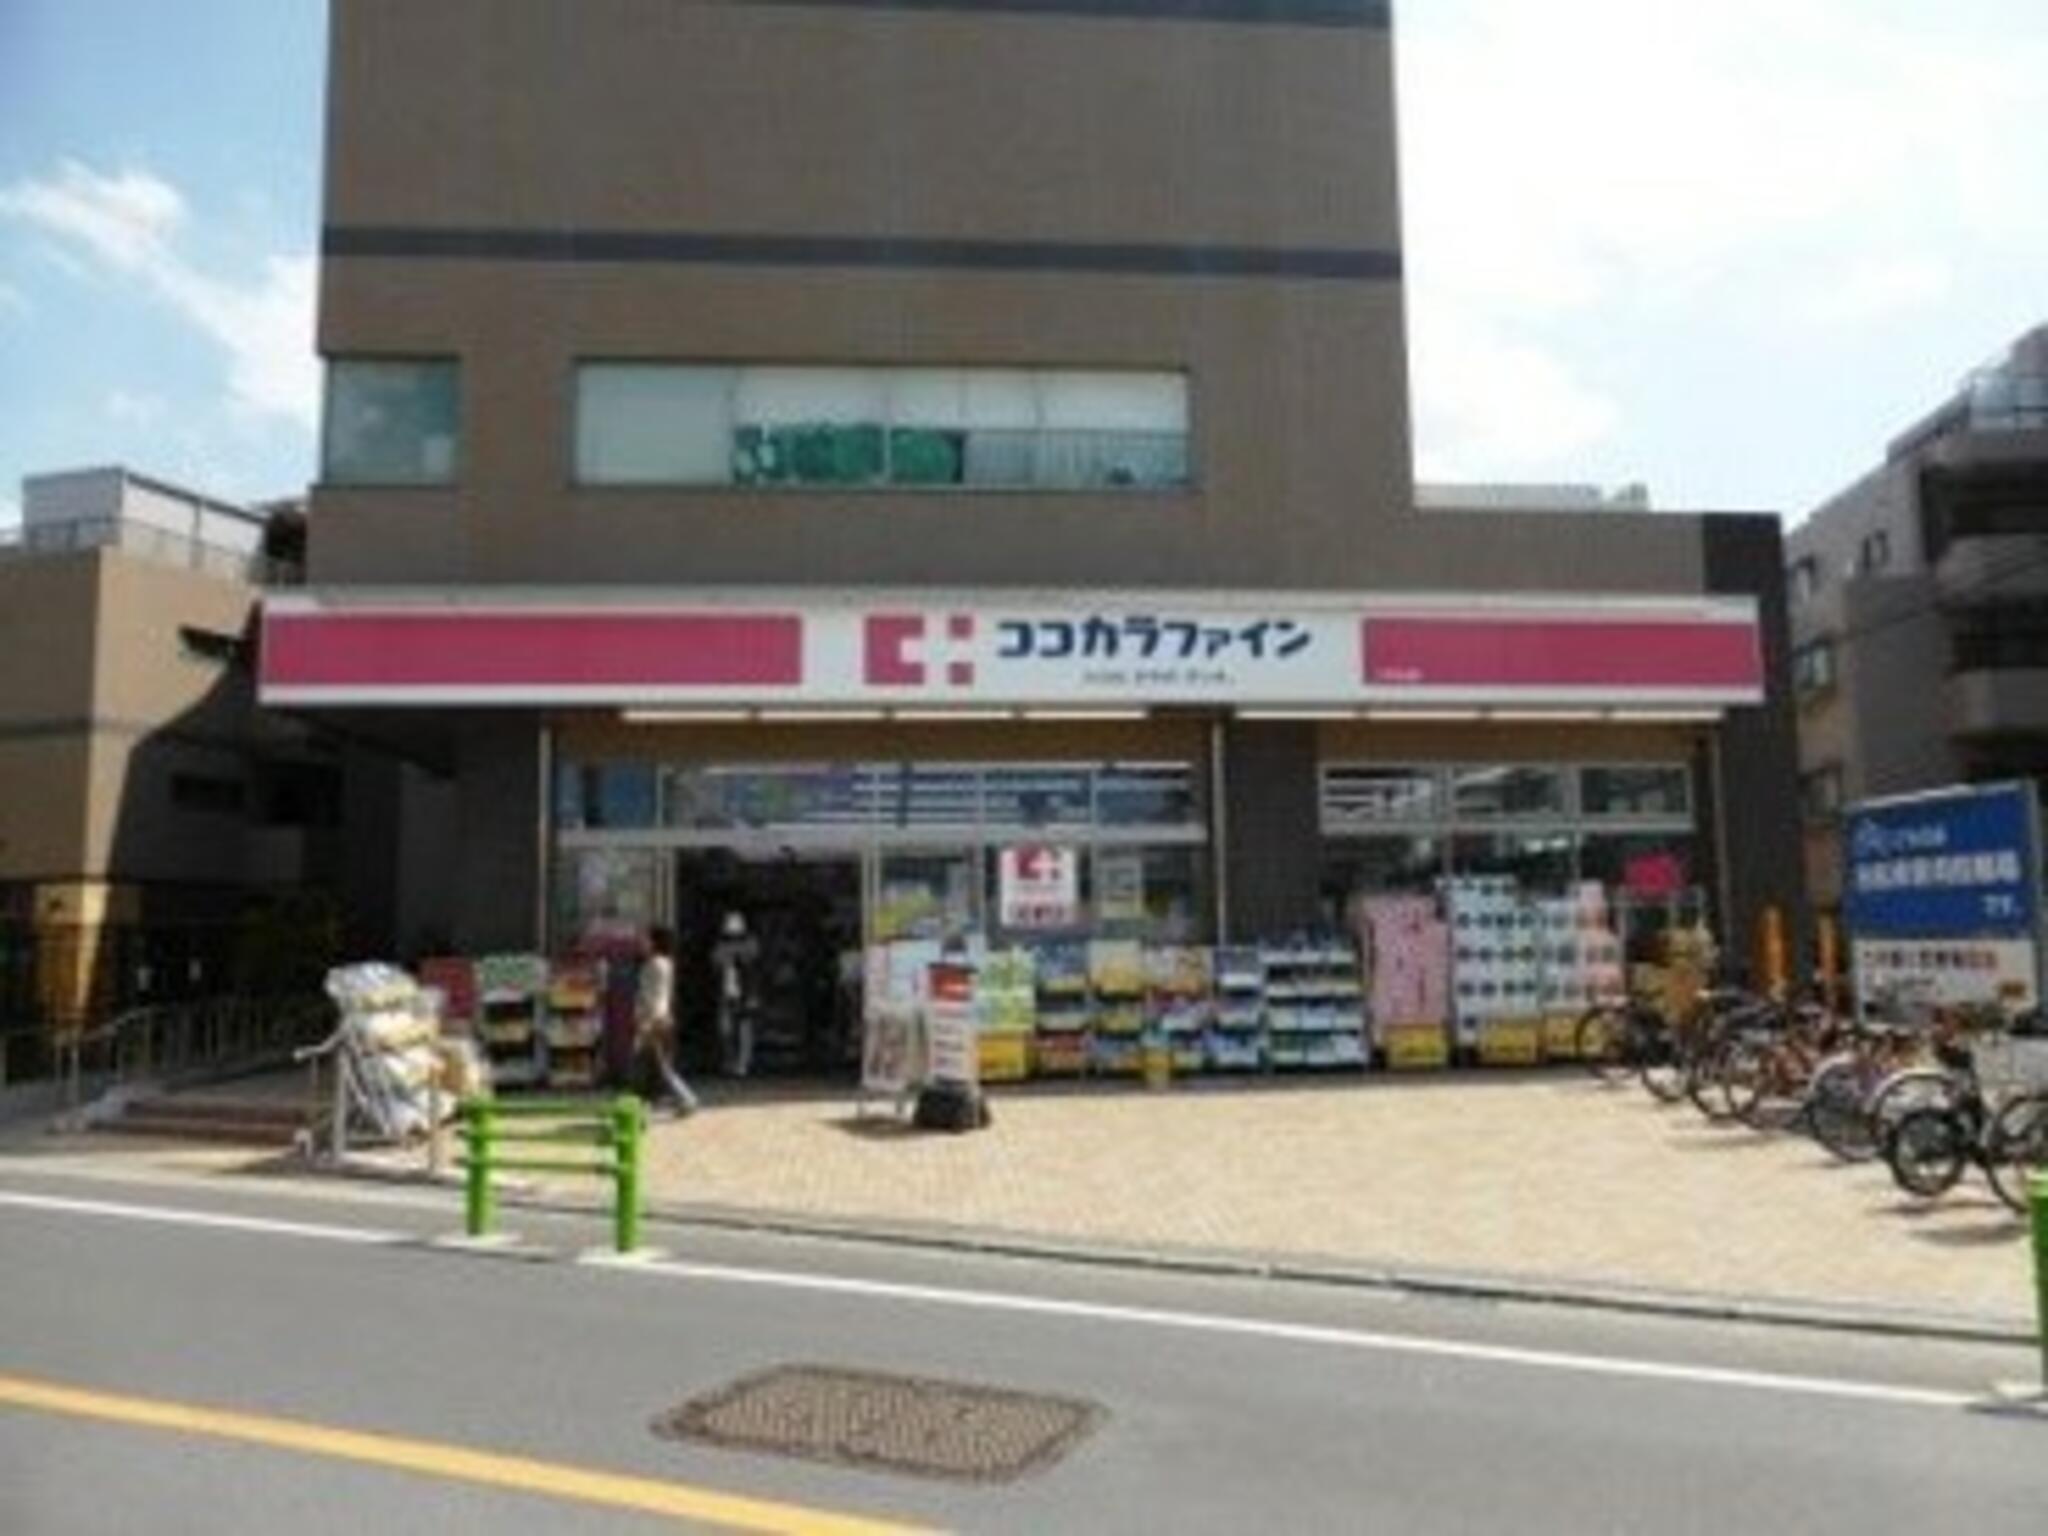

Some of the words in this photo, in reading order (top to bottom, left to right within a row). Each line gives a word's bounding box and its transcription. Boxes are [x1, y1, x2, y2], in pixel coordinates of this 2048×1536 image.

[997, 616, 1311, 659] ココカラファイン
